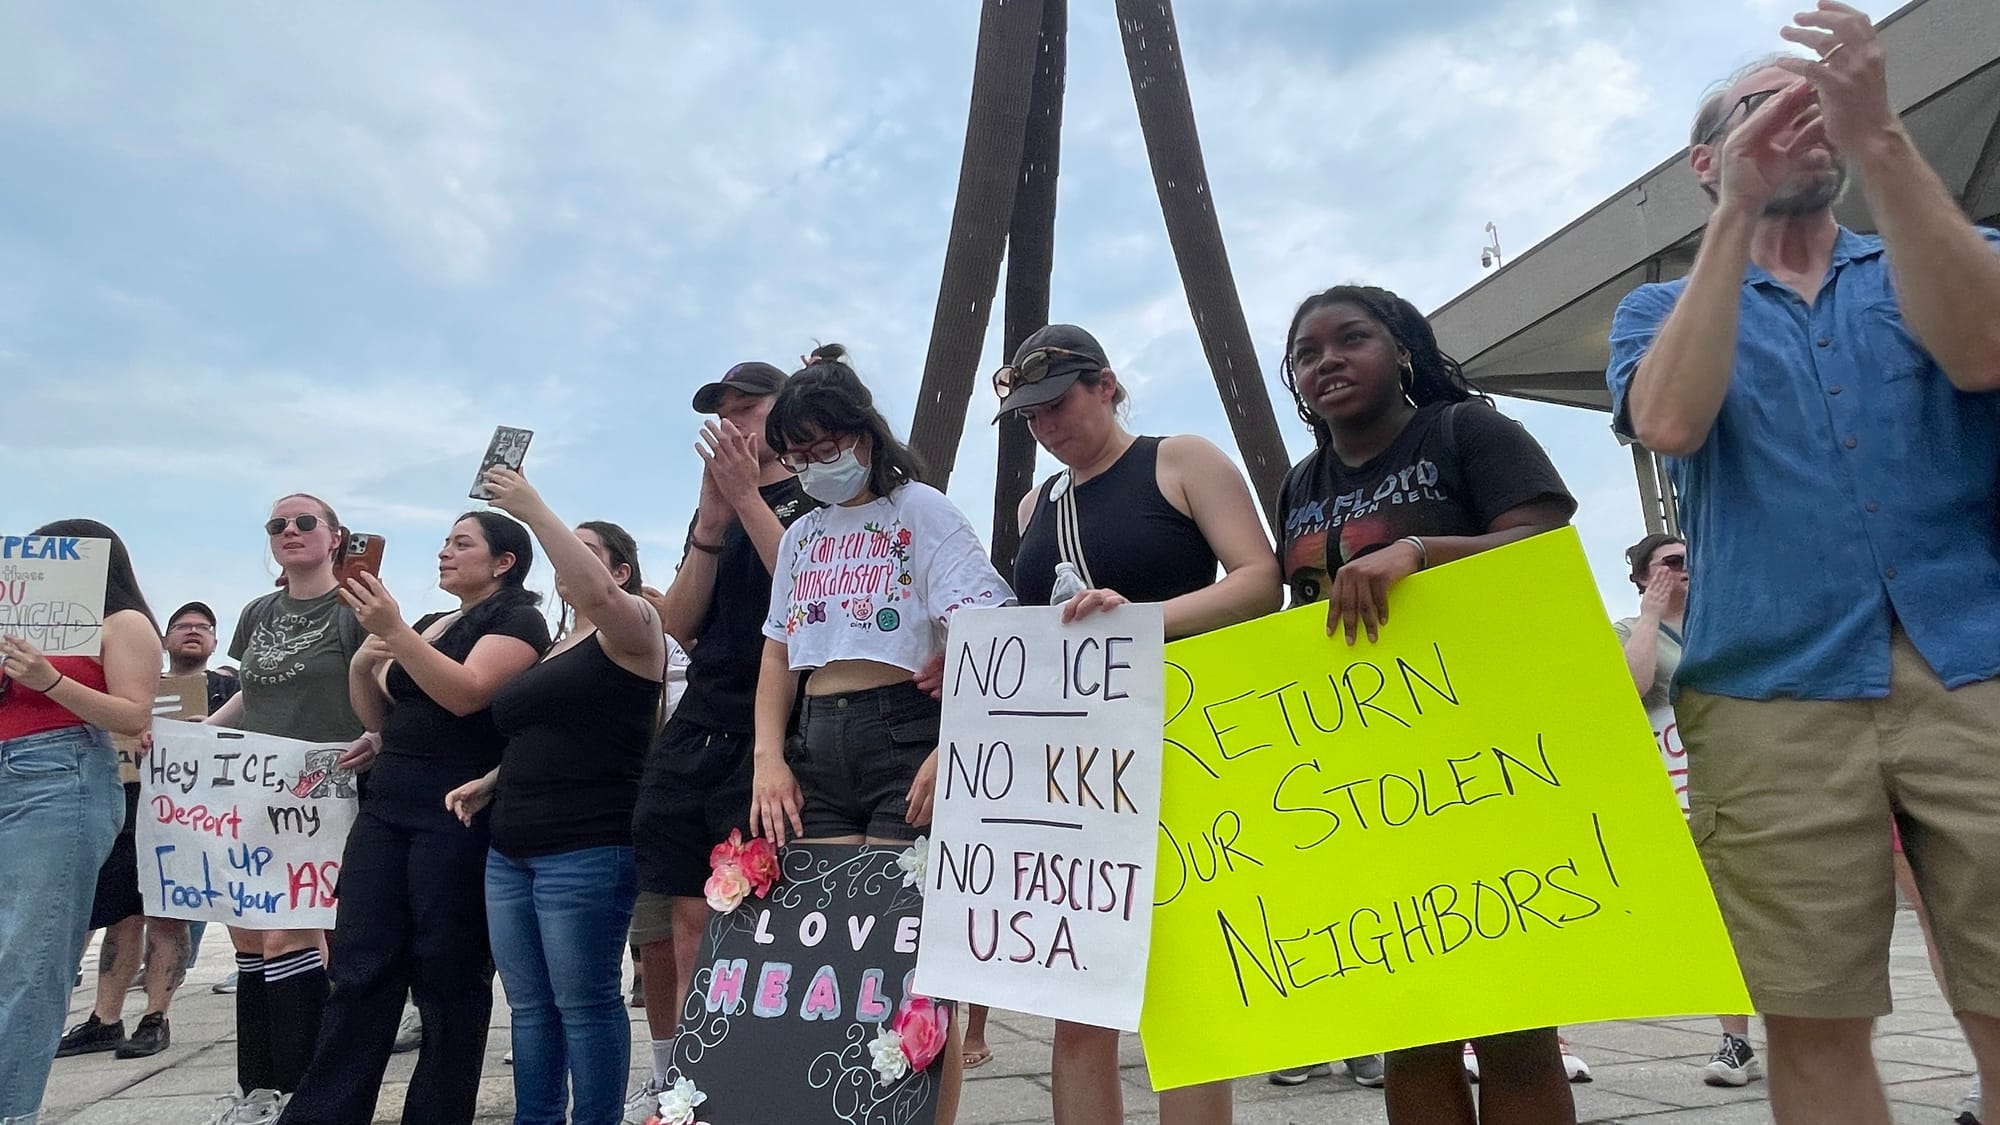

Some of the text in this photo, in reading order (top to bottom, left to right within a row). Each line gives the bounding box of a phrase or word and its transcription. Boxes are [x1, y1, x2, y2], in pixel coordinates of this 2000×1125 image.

[1332, 458, 1439, 518] FLOYD
[1391, 486, 1448, 505] BELL
[0, 536, 81, 560] PEAK
[838, 532, 866, 560] tell
[953, 636, 1134, 701] NO ICE
[1163, 642, 1460, 778] RETURN
[150, 741, 198, 793] Hey
[211, 752, 285, 793] ICE,
[945, 741, 1139, 814] NO KKK
[267, 804, 321, 838] my
[1153, 810, 1264, 906] OUR
[1273, 733, 1561, 850] STOLEN
[155, 845, 223, 911] Foot
[937, 840, 1142, 921] NO FASCIST
[1217, 812, 1633, 1007] NEIGHBORS!
[754, 908, 920, 953] LOVE
[968, 907, 1088, 971] U.S.A.
[706, 958, 917, 1024] HEAL
